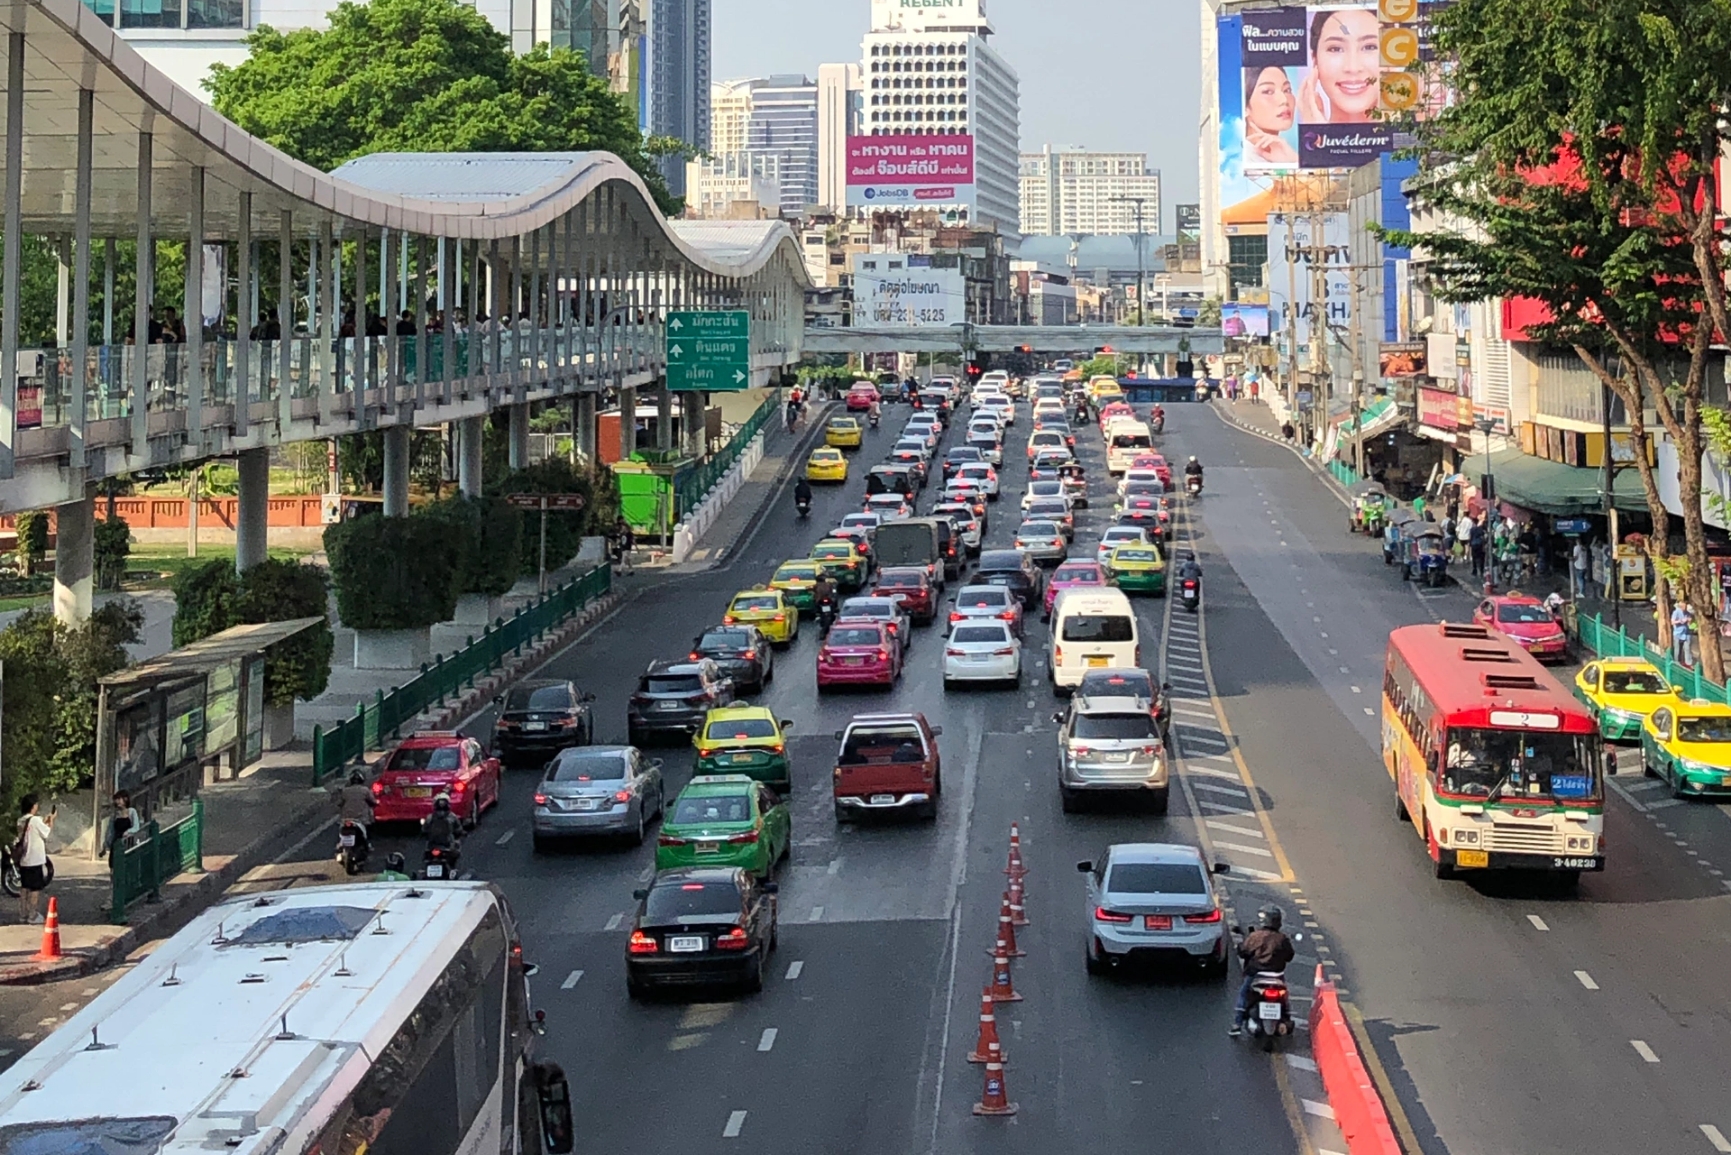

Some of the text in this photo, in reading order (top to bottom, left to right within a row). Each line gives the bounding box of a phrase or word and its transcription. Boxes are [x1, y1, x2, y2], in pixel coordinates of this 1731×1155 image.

[862, 145, 907, 156] หางาน
[928, 144, 967, 155] หาคน
[876, 188, 909, 198] JobsDB
[1520, 714, 1530, 727] 2
[1552, 778, 1562, 789] 2
